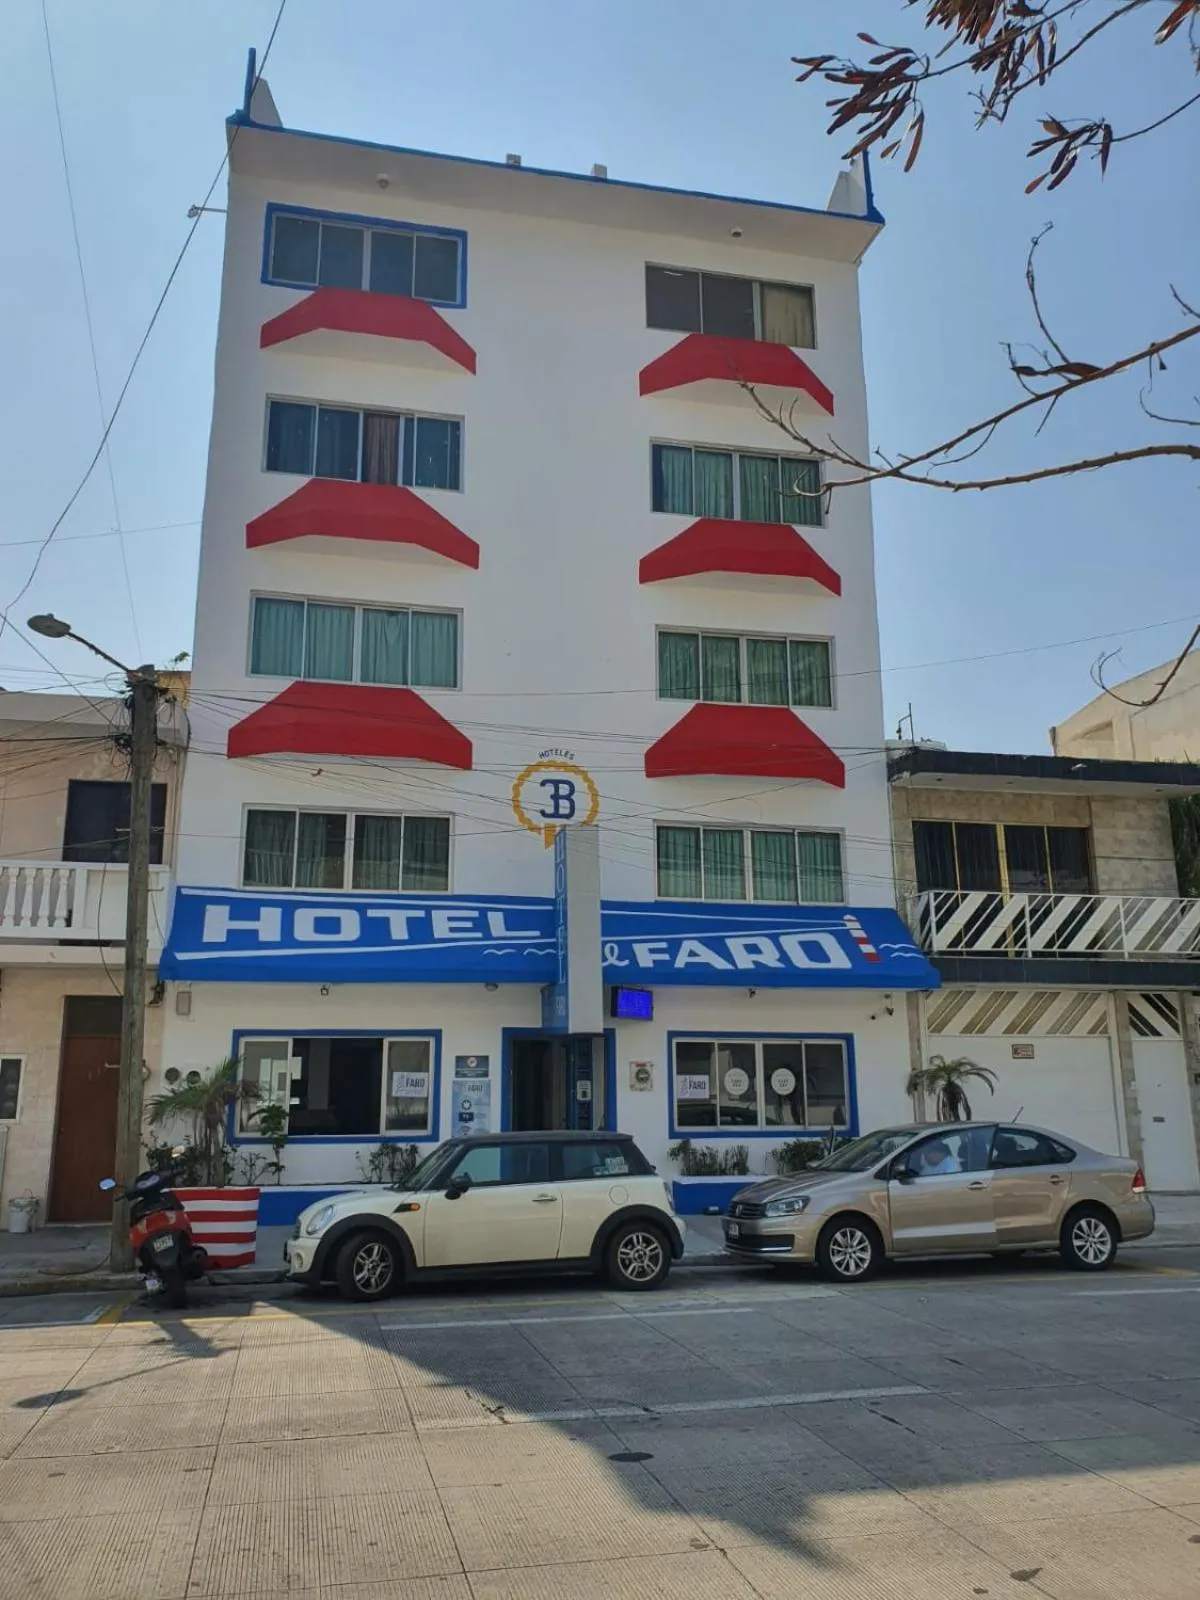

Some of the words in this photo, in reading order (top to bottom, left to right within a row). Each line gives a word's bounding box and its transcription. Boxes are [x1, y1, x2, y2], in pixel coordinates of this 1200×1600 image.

[538, 748, 575, 760] HOTELES
[202, 904, 541, 943] HOTEL
[632, 931, 852, 969] FARO
[556, 831, 567, 985] HOTEL
